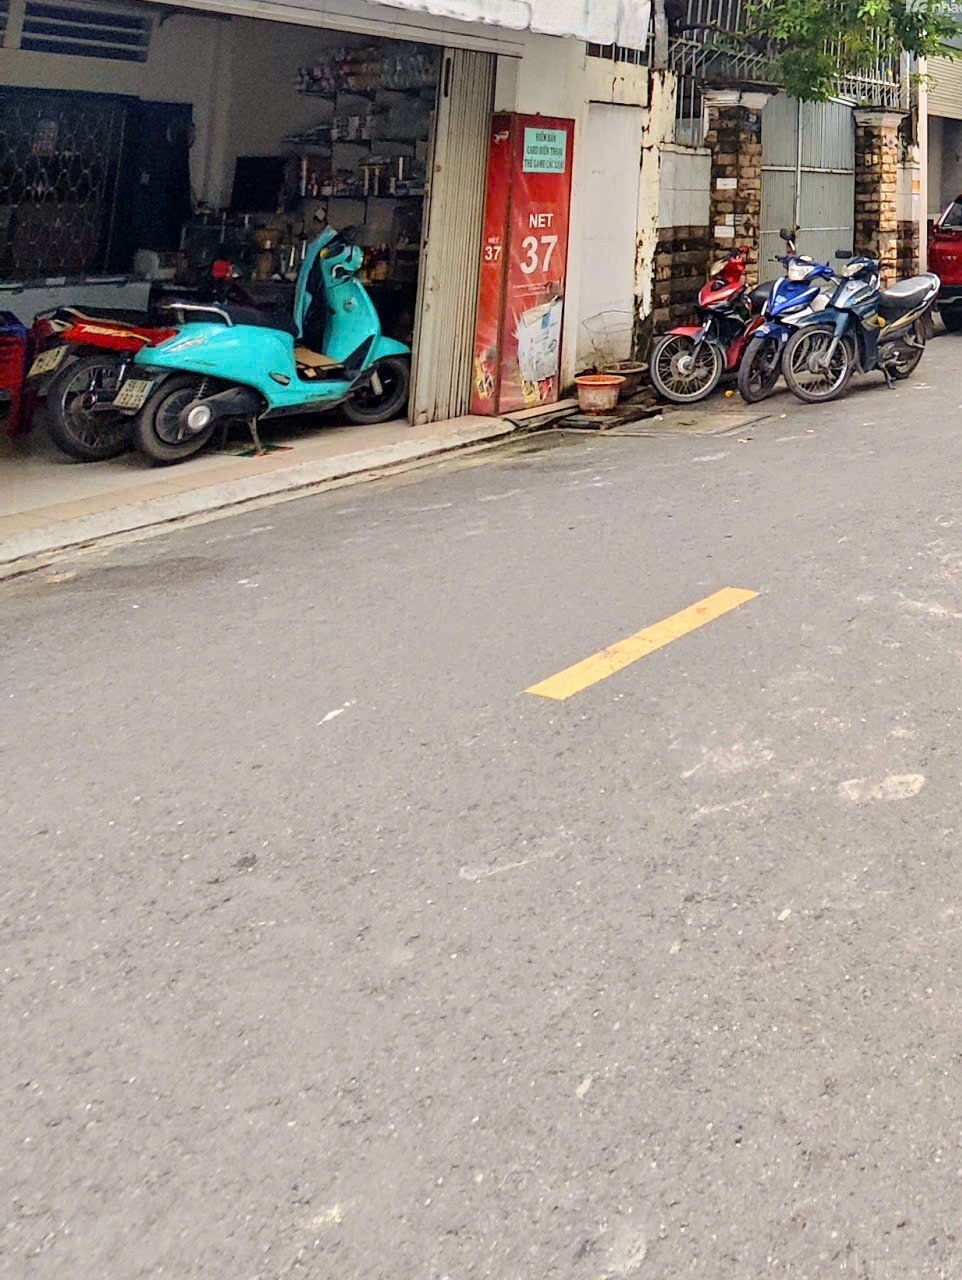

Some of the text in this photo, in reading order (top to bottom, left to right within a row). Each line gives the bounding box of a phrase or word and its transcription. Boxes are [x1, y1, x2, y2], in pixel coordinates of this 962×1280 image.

[528, 213, 554, 228] NET
[484, 245, 502, 260] 37
[520, 235, 558, 274] 37
